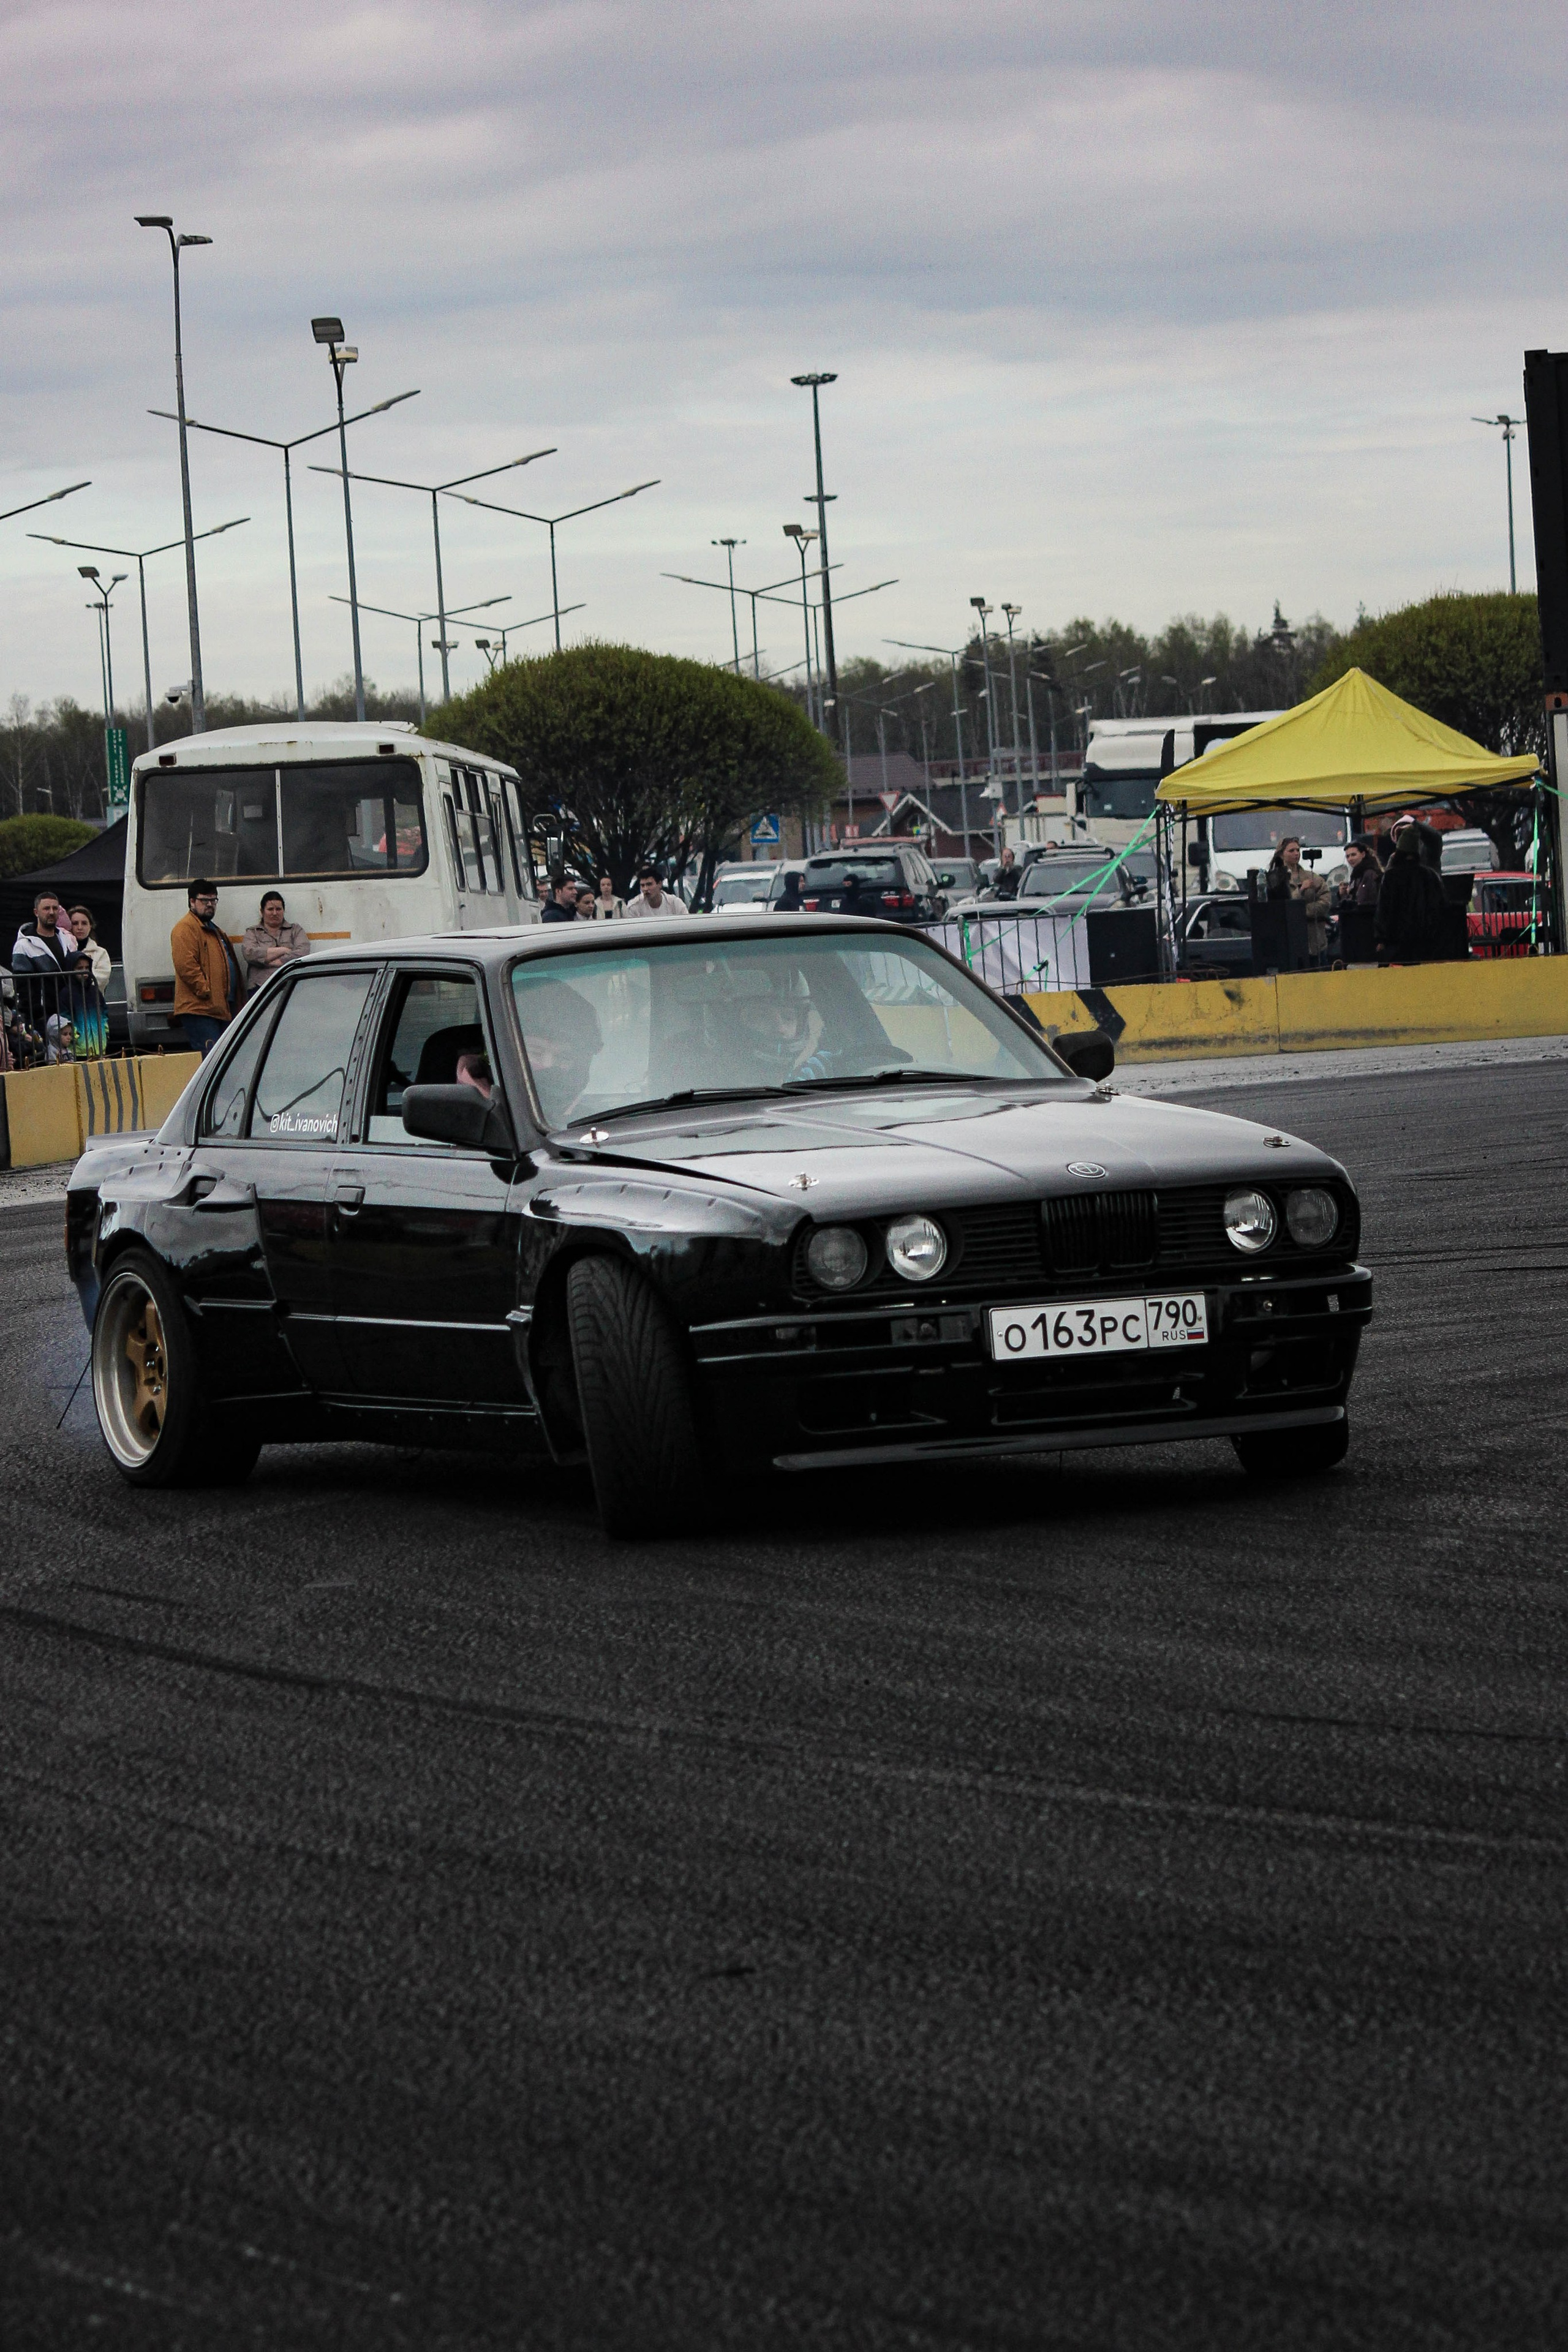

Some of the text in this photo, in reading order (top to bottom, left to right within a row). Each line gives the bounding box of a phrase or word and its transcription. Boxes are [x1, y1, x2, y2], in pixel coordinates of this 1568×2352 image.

[270, 1112, 338, 1133] @kit_ivanovich
[1148, 1299, 1197, 1330] 790
[1162, 1330, 1186, 1341] RUS
